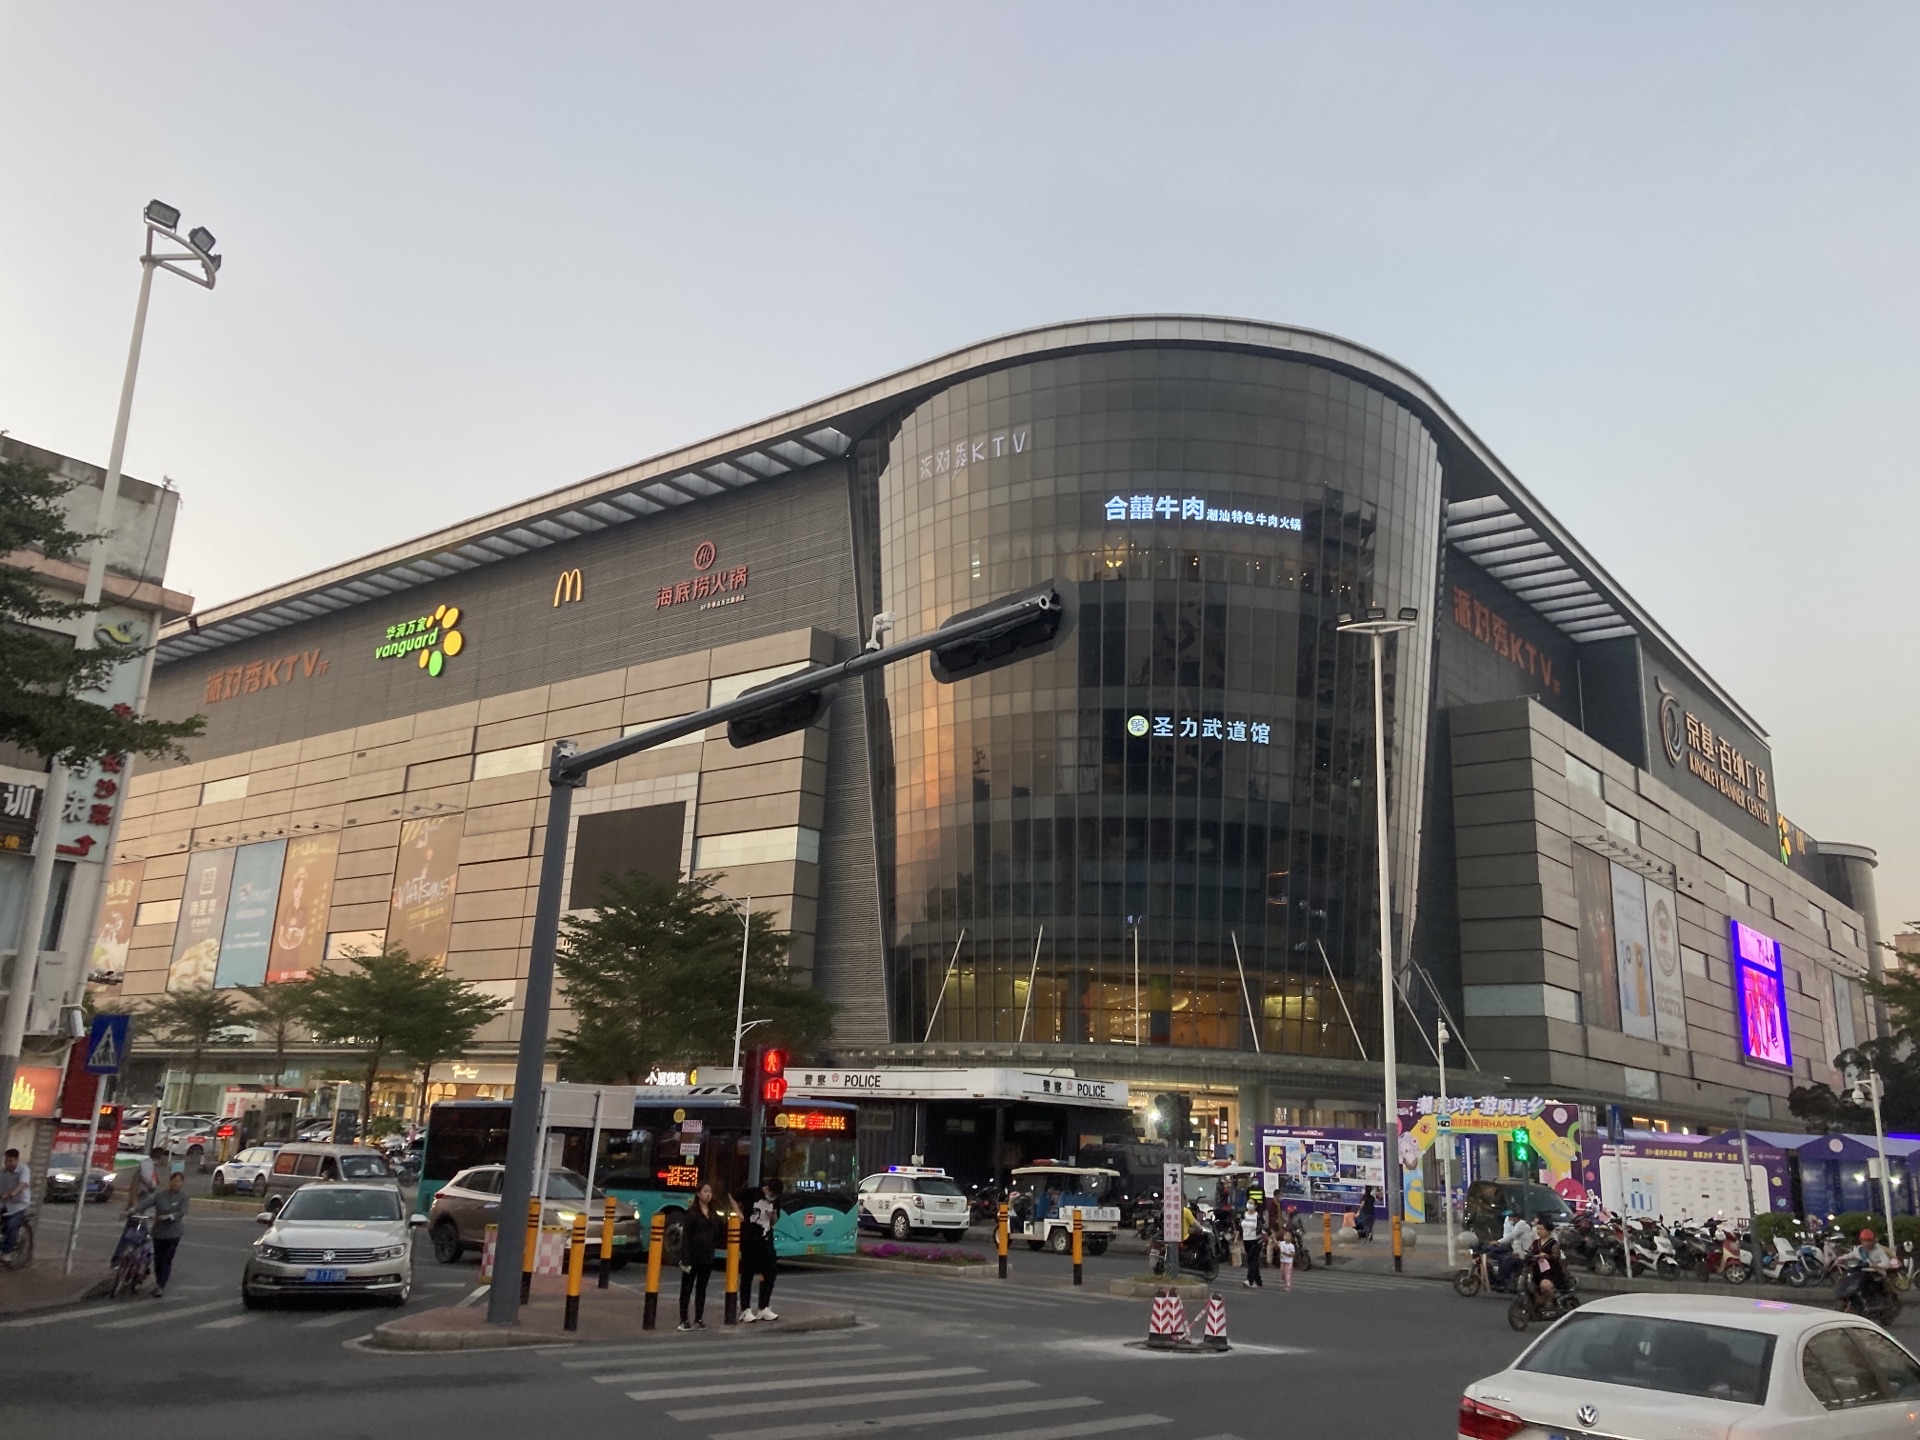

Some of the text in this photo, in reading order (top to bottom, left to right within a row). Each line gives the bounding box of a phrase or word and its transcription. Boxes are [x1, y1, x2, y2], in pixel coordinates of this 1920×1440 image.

[1206, 508, 1301, 531] 潮汕特色牛肉火锅
[656, 565, 748, 610] 海底捞火锅
[385, 616, 427, 641] 华润万家
[375, 627, 439, 660] vanguard
[1153, 716, 1271, 745] 圣力武道馆
[3, 784, 36, 819] 训
[1688, 752, 1721, 790] KINGKEY
[1747, 795, 1771, 826] CENTER
[765, 1083, 780, 1099] 14
[804, 1073, 882, 1088] 警察 POLICE
[1077, 1083, 1106, 1098] POLICE
